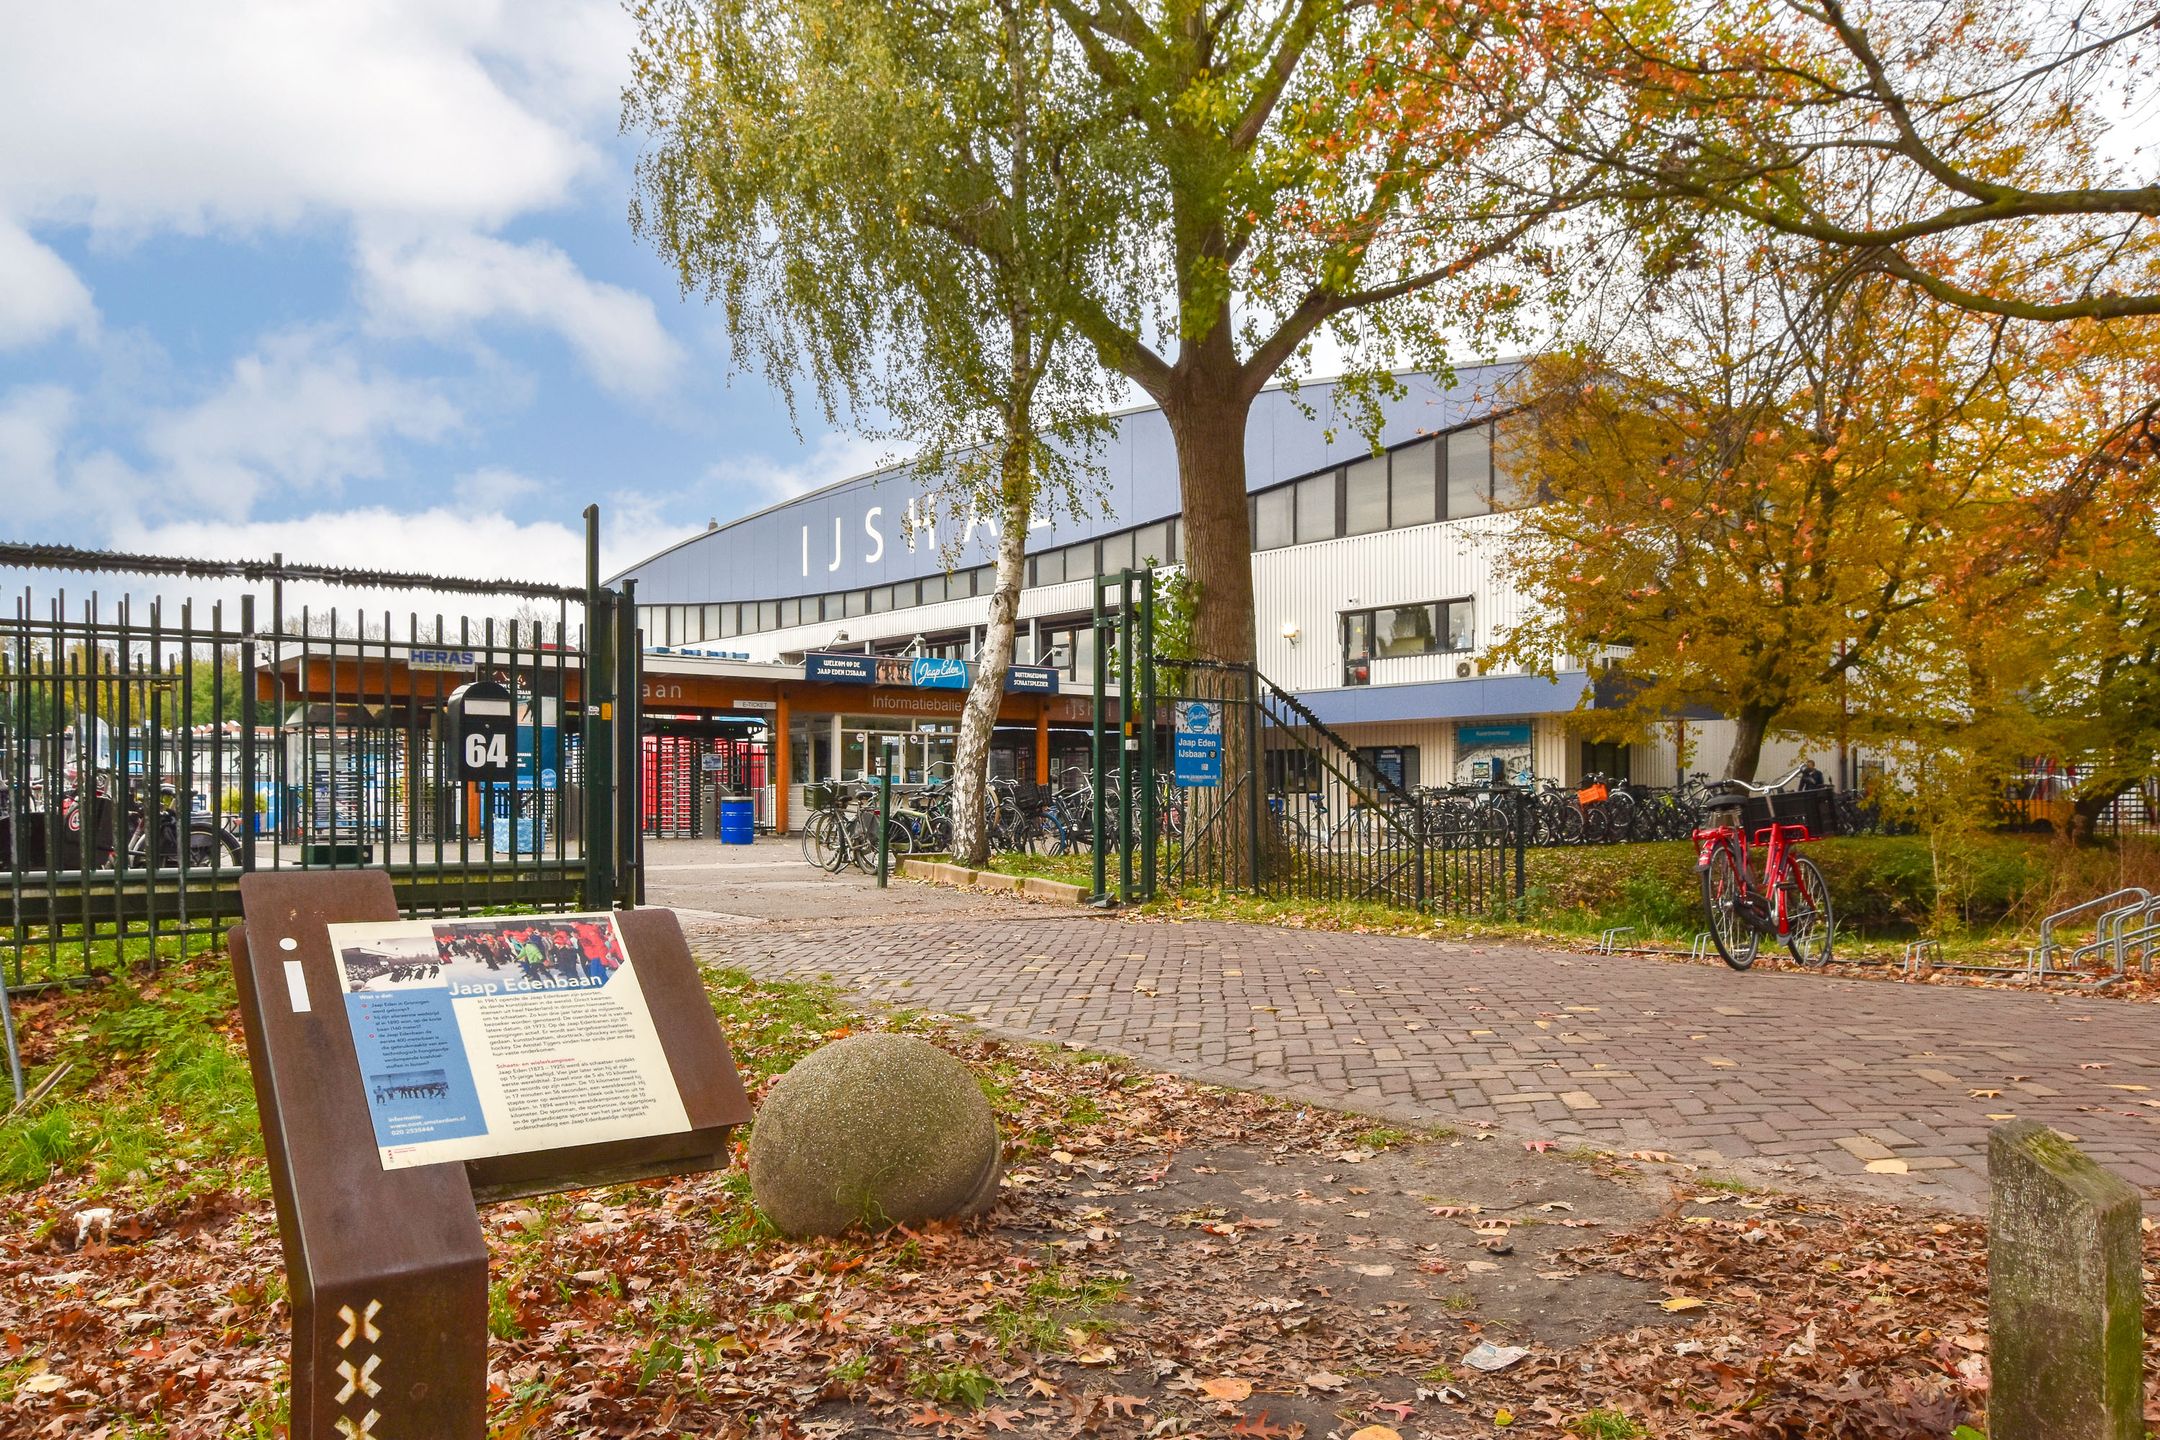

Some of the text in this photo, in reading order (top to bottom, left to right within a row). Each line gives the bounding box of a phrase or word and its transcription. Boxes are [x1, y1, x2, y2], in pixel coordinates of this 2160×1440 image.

[411, 650, 473, 664] HERAS
[918, 660, 961, 685] Jaap Eden
[872, 695, 962, 712] Informatiebalie
[1178, 738, 1216, 748] Jaap Eden
[465, 733, 508, 768] 64
[1178, 750, 1207, 758] IJsbaan
[448, 973, 602, 996] Jaap Edenbaan
[577, 1095, 622, 1105] wereldkampioen
[628, 1098, 657, 1106] sportploeg
[530, 1114, 568, 1124] gehandicapte
[514, 1122, 558, 1132] onderscheiding
